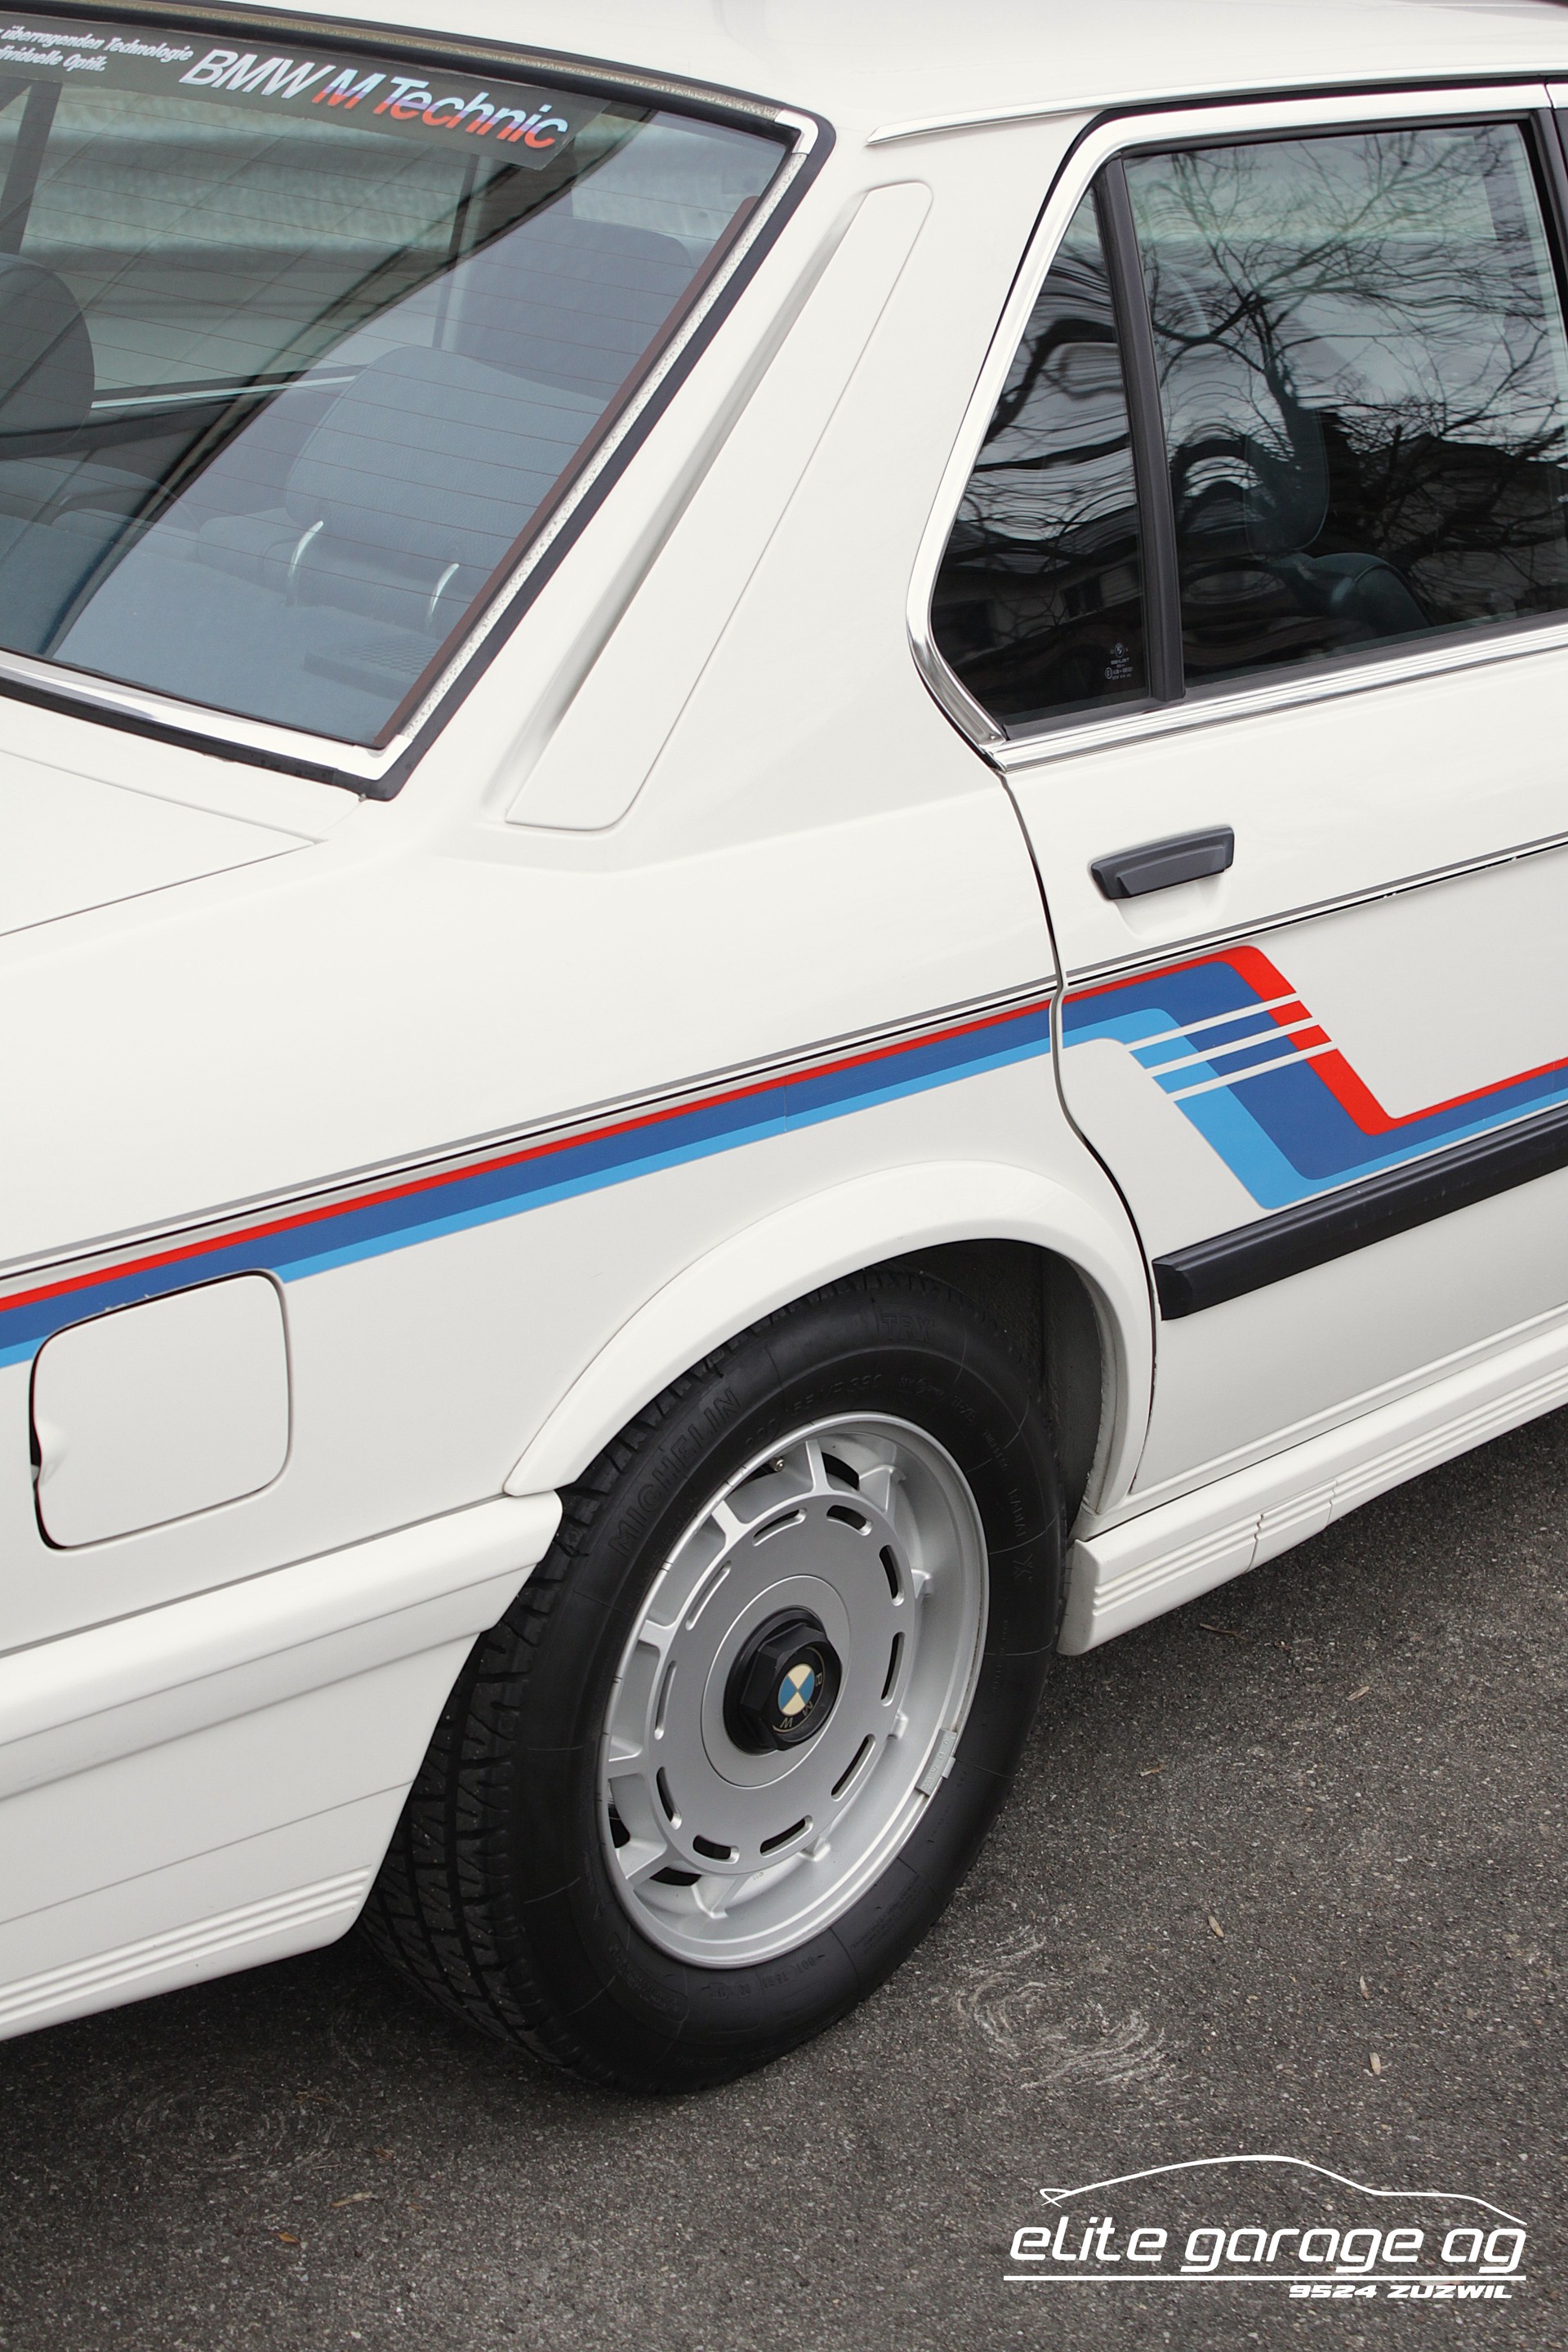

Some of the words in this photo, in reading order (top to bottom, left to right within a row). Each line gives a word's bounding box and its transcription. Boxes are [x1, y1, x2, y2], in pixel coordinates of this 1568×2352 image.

[1, 25, 105, 51] überragenden
[103, 37, 194, 63] Technologie
[63, 53, 108, 72] Optik.
[178, 49, 336, 100] BMW
[311, 68, 387, 110] M
[372, 76, 568, 149] Technic
[608, 1387, 742, 1559] MICHELIN
[779, 1672, 822, 1729] BMW
